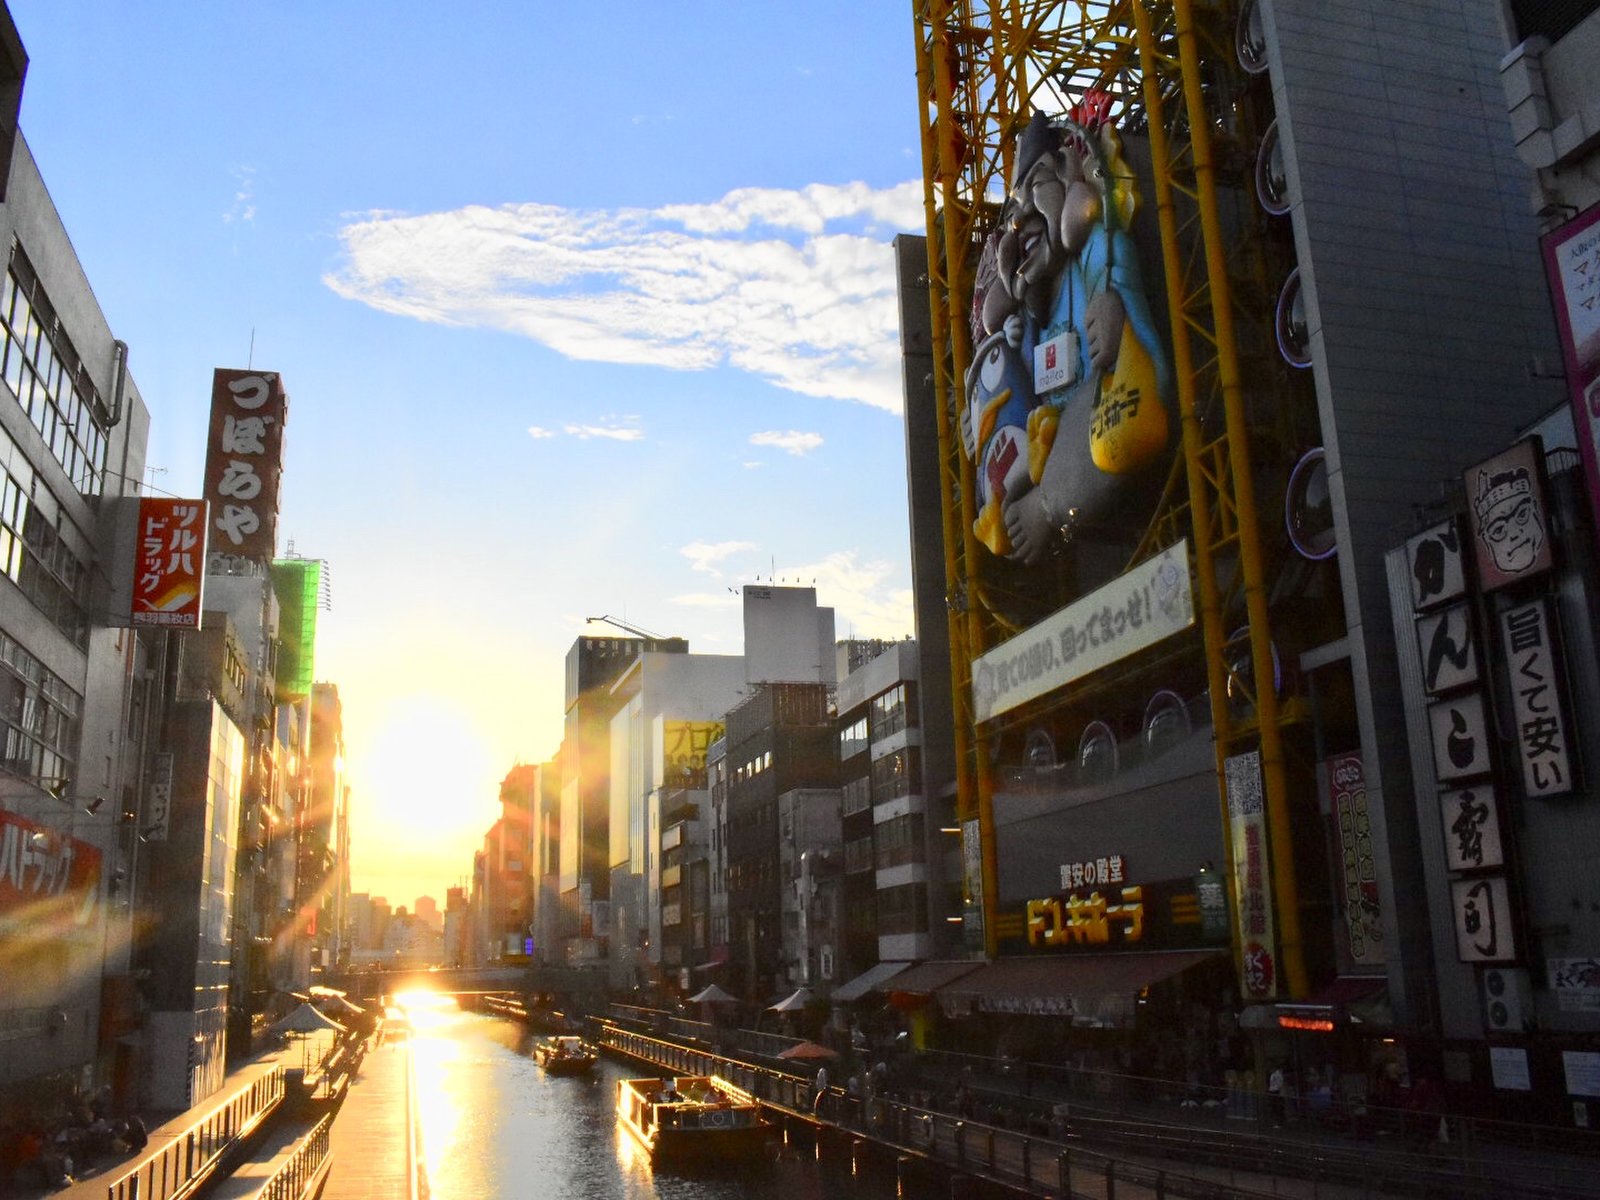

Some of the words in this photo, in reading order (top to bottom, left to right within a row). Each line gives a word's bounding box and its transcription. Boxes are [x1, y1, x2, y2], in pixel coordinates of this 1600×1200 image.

[215, 372, 277, 546] づぼらや
[139, 516, 169, 593] ドラッグ
[167, 505, 199, 576] ツルハ
[1506, 606, 1563, 790] 旨くて安い
[1060, 855, 1124, 890] 驚安の殿堂
